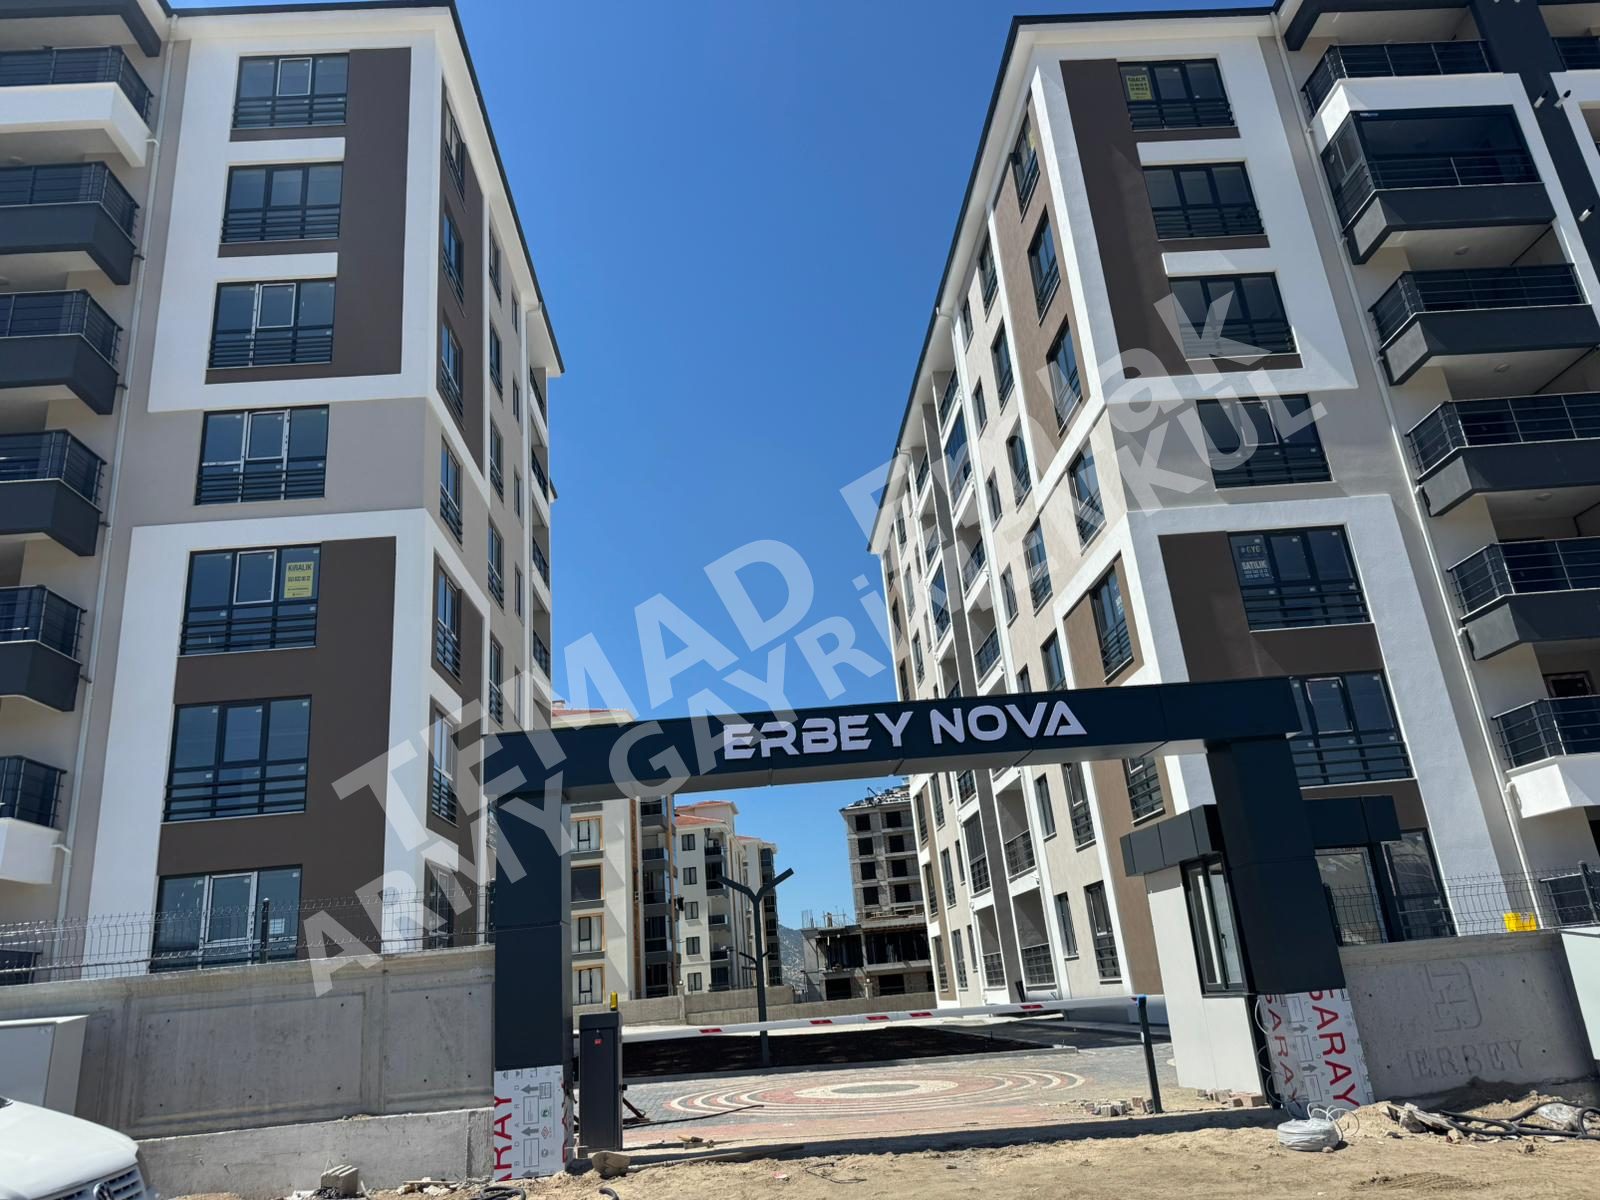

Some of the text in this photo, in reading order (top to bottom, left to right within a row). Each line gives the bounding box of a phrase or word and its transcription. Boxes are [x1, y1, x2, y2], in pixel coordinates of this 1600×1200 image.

[723, 700, 1088, 760] ERBEY NOVA
[1309, 989, 1360, 1107] SARAY
